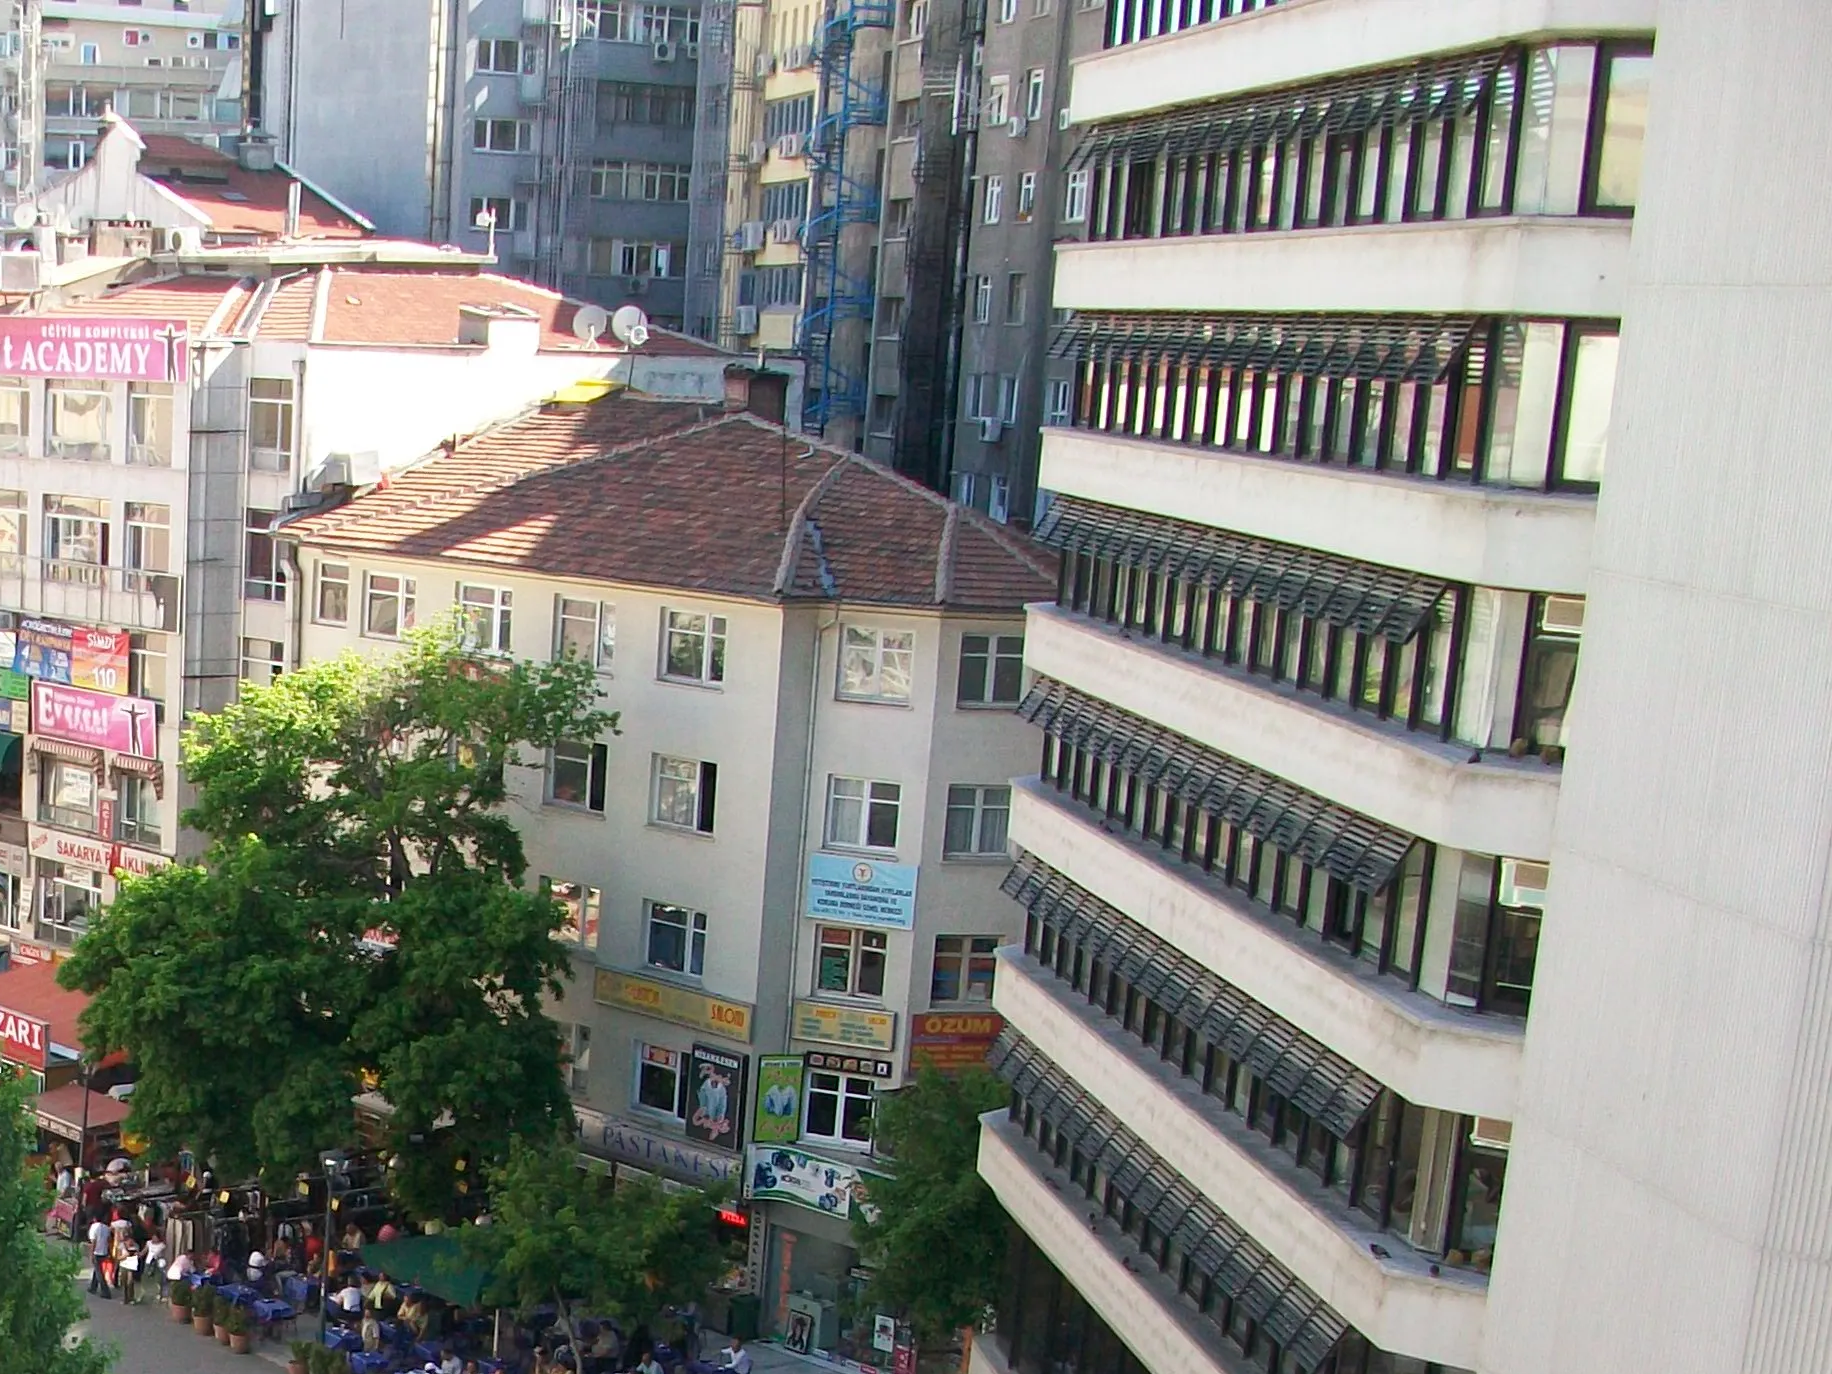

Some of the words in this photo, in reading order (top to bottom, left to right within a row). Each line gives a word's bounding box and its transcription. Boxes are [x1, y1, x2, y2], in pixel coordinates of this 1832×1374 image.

[20, 341, 151, 375] ACADEMY
[92, 667, 116, 688] 110
[57, 840, 102, 865] SAKARYA
